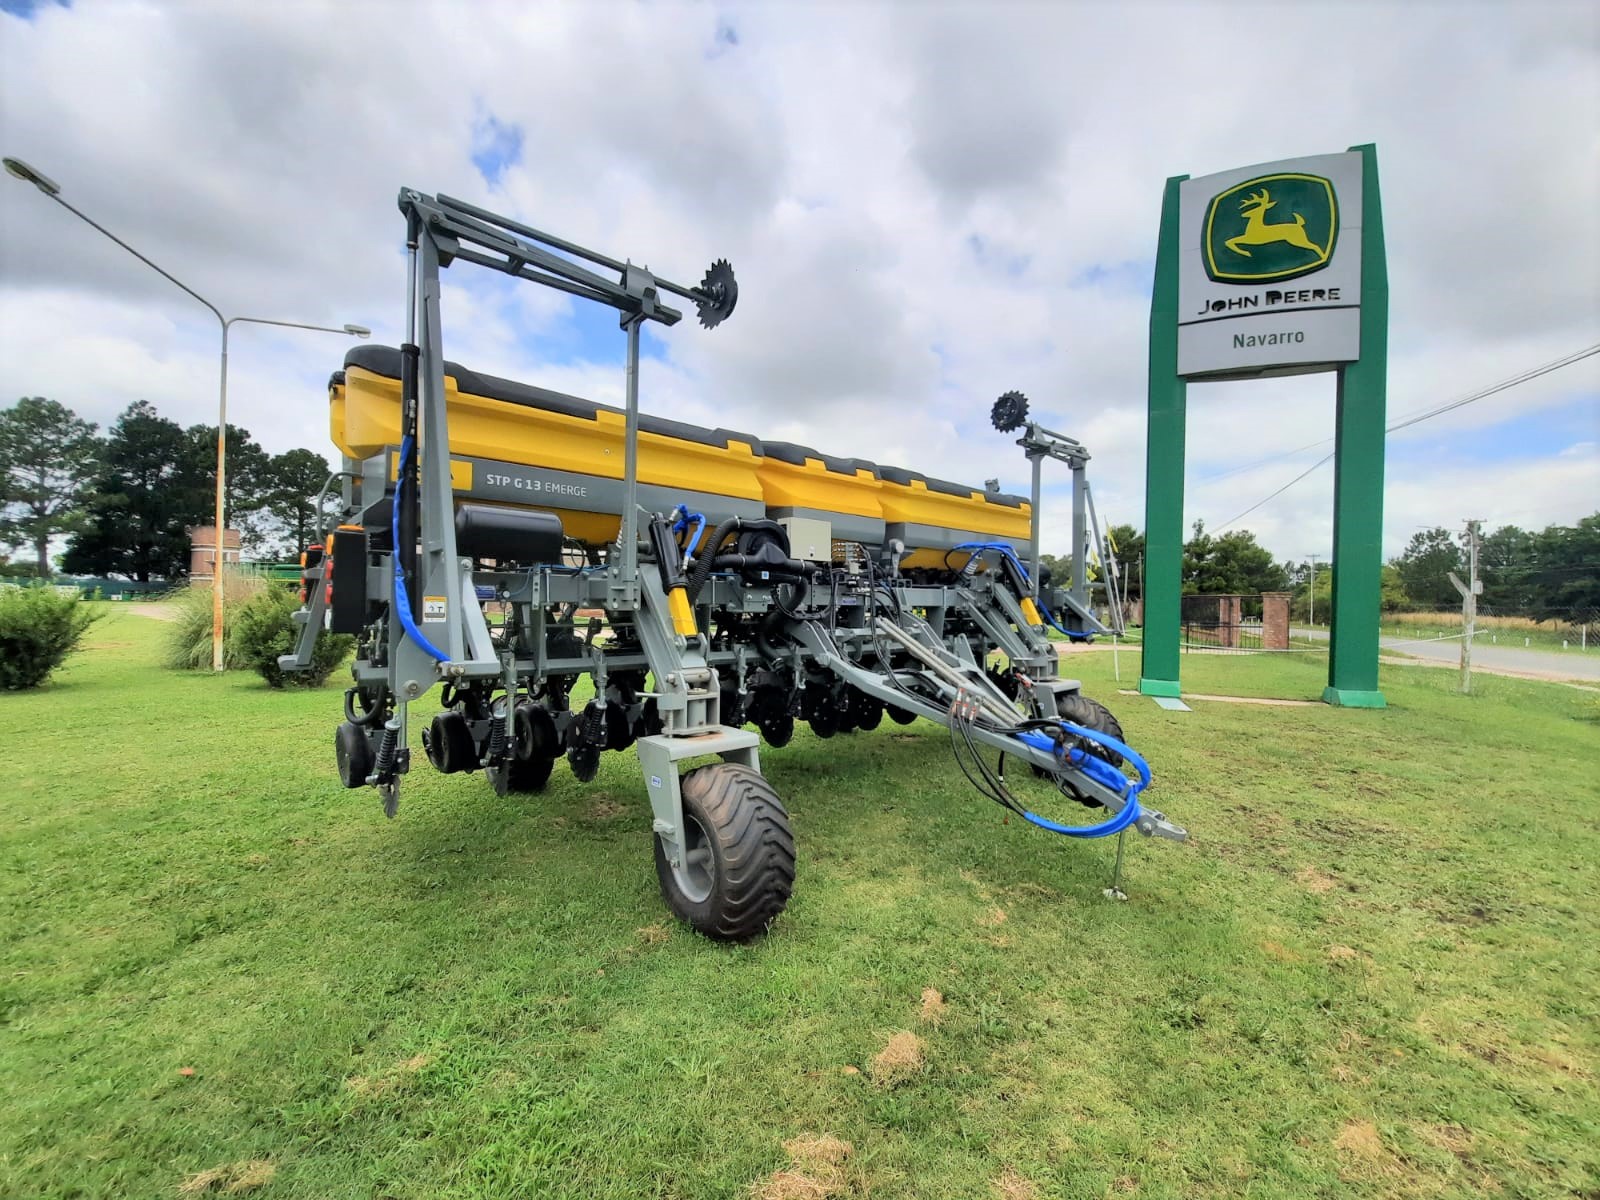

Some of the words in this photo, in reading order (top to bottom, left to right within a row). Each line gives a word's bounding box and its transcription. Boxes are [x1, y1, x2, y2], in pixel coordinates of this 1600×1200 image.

[1198, 295, 1259, 315] JOHN
[1233, 331, 1305, 349] Navarro
[486, 474, 511, 486] STP
[545, 482, 587, 497] EMERGE
